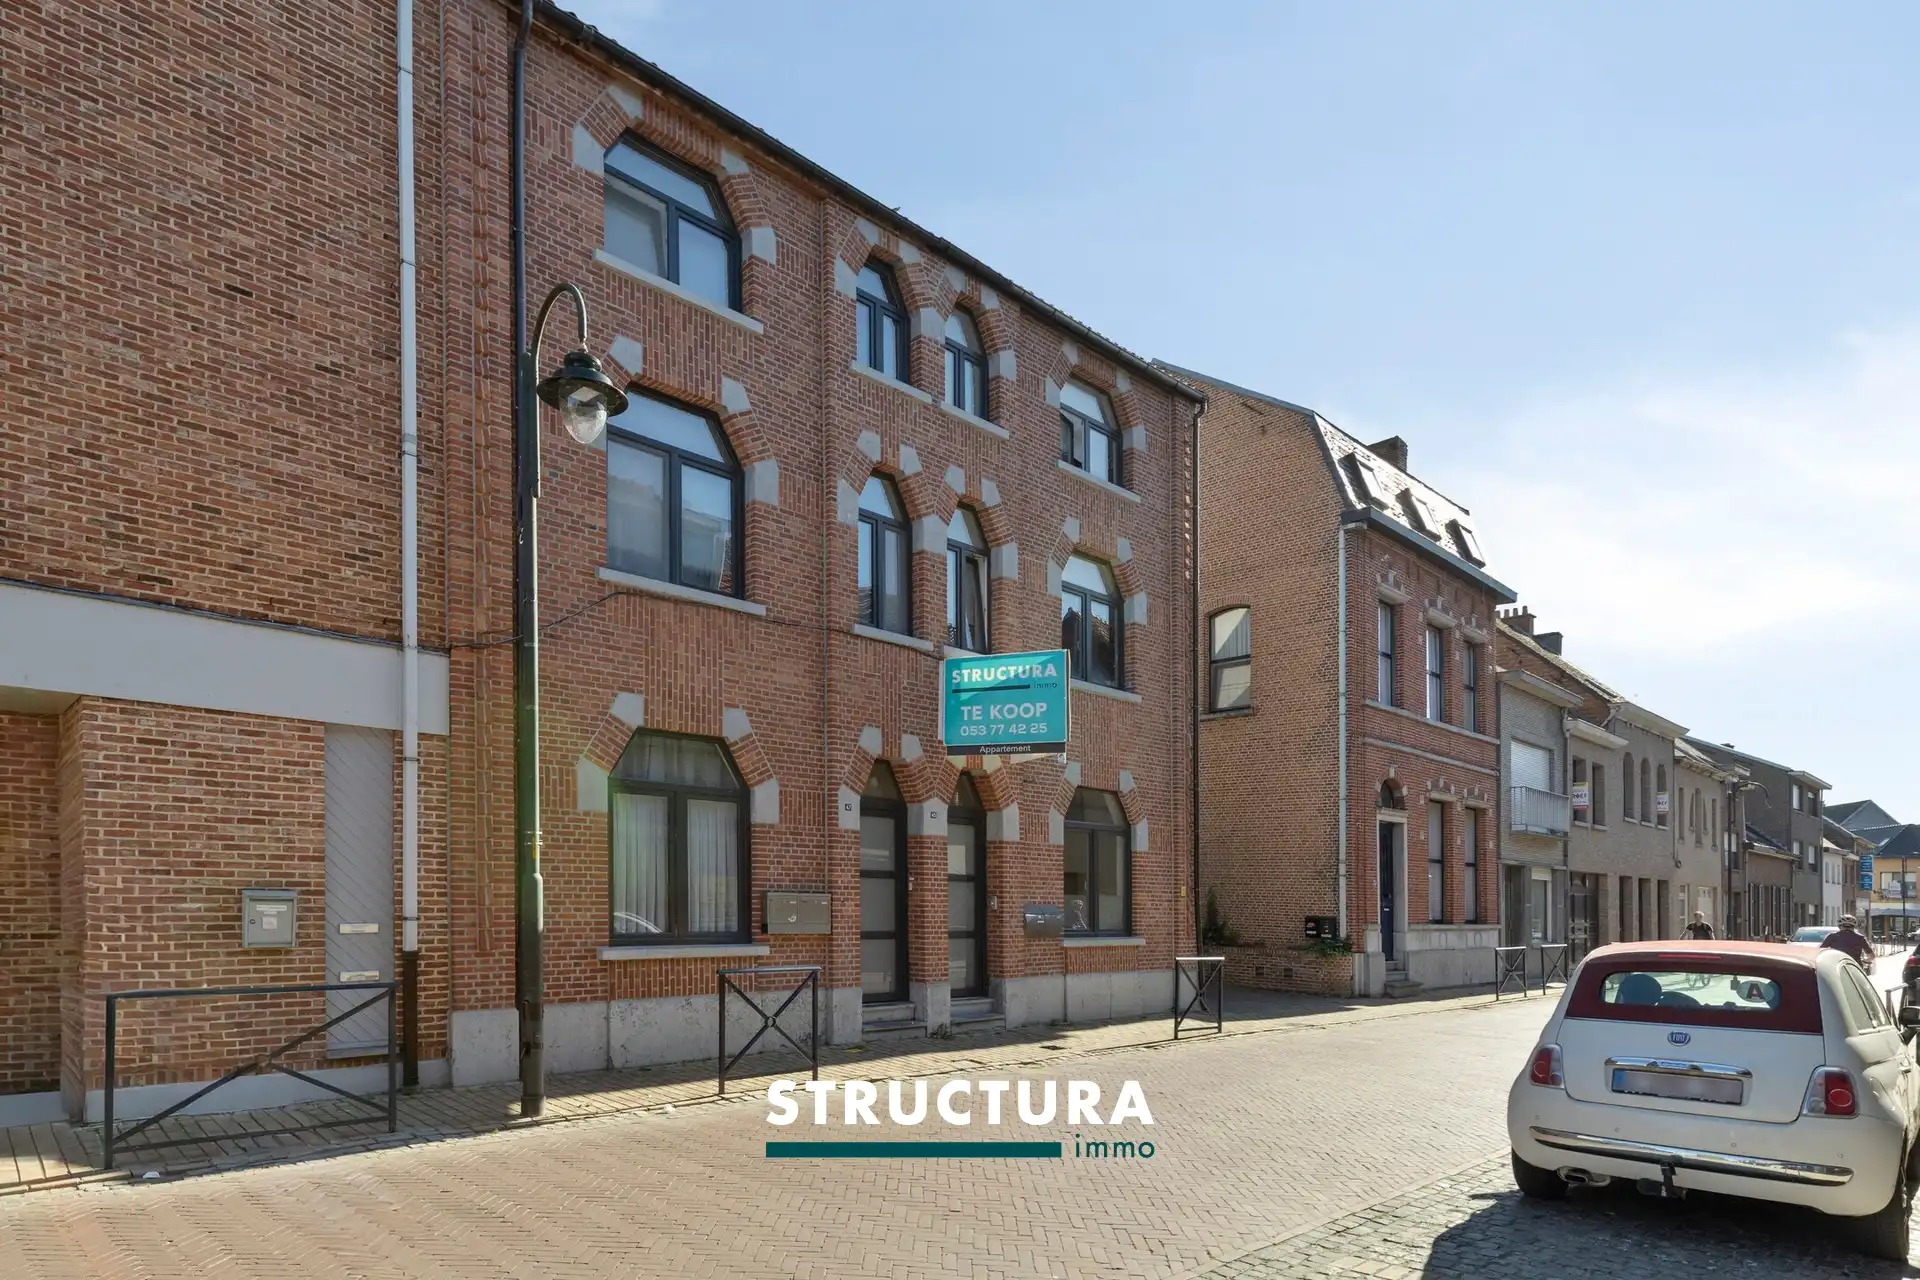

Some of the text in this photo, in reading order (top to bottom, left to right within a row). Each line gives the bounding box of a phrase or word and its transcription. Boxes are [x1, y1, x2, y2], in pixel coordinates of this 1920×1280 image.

[952, 664, 1057, 683] STRUCTURA
[960, 702, 1048, 721] TE KOOP
[960, 722, 1048, 736] 053 77 42 25
[979, 745, 1031, 755] Appartement
[1746, 983, 1765, 999] A
